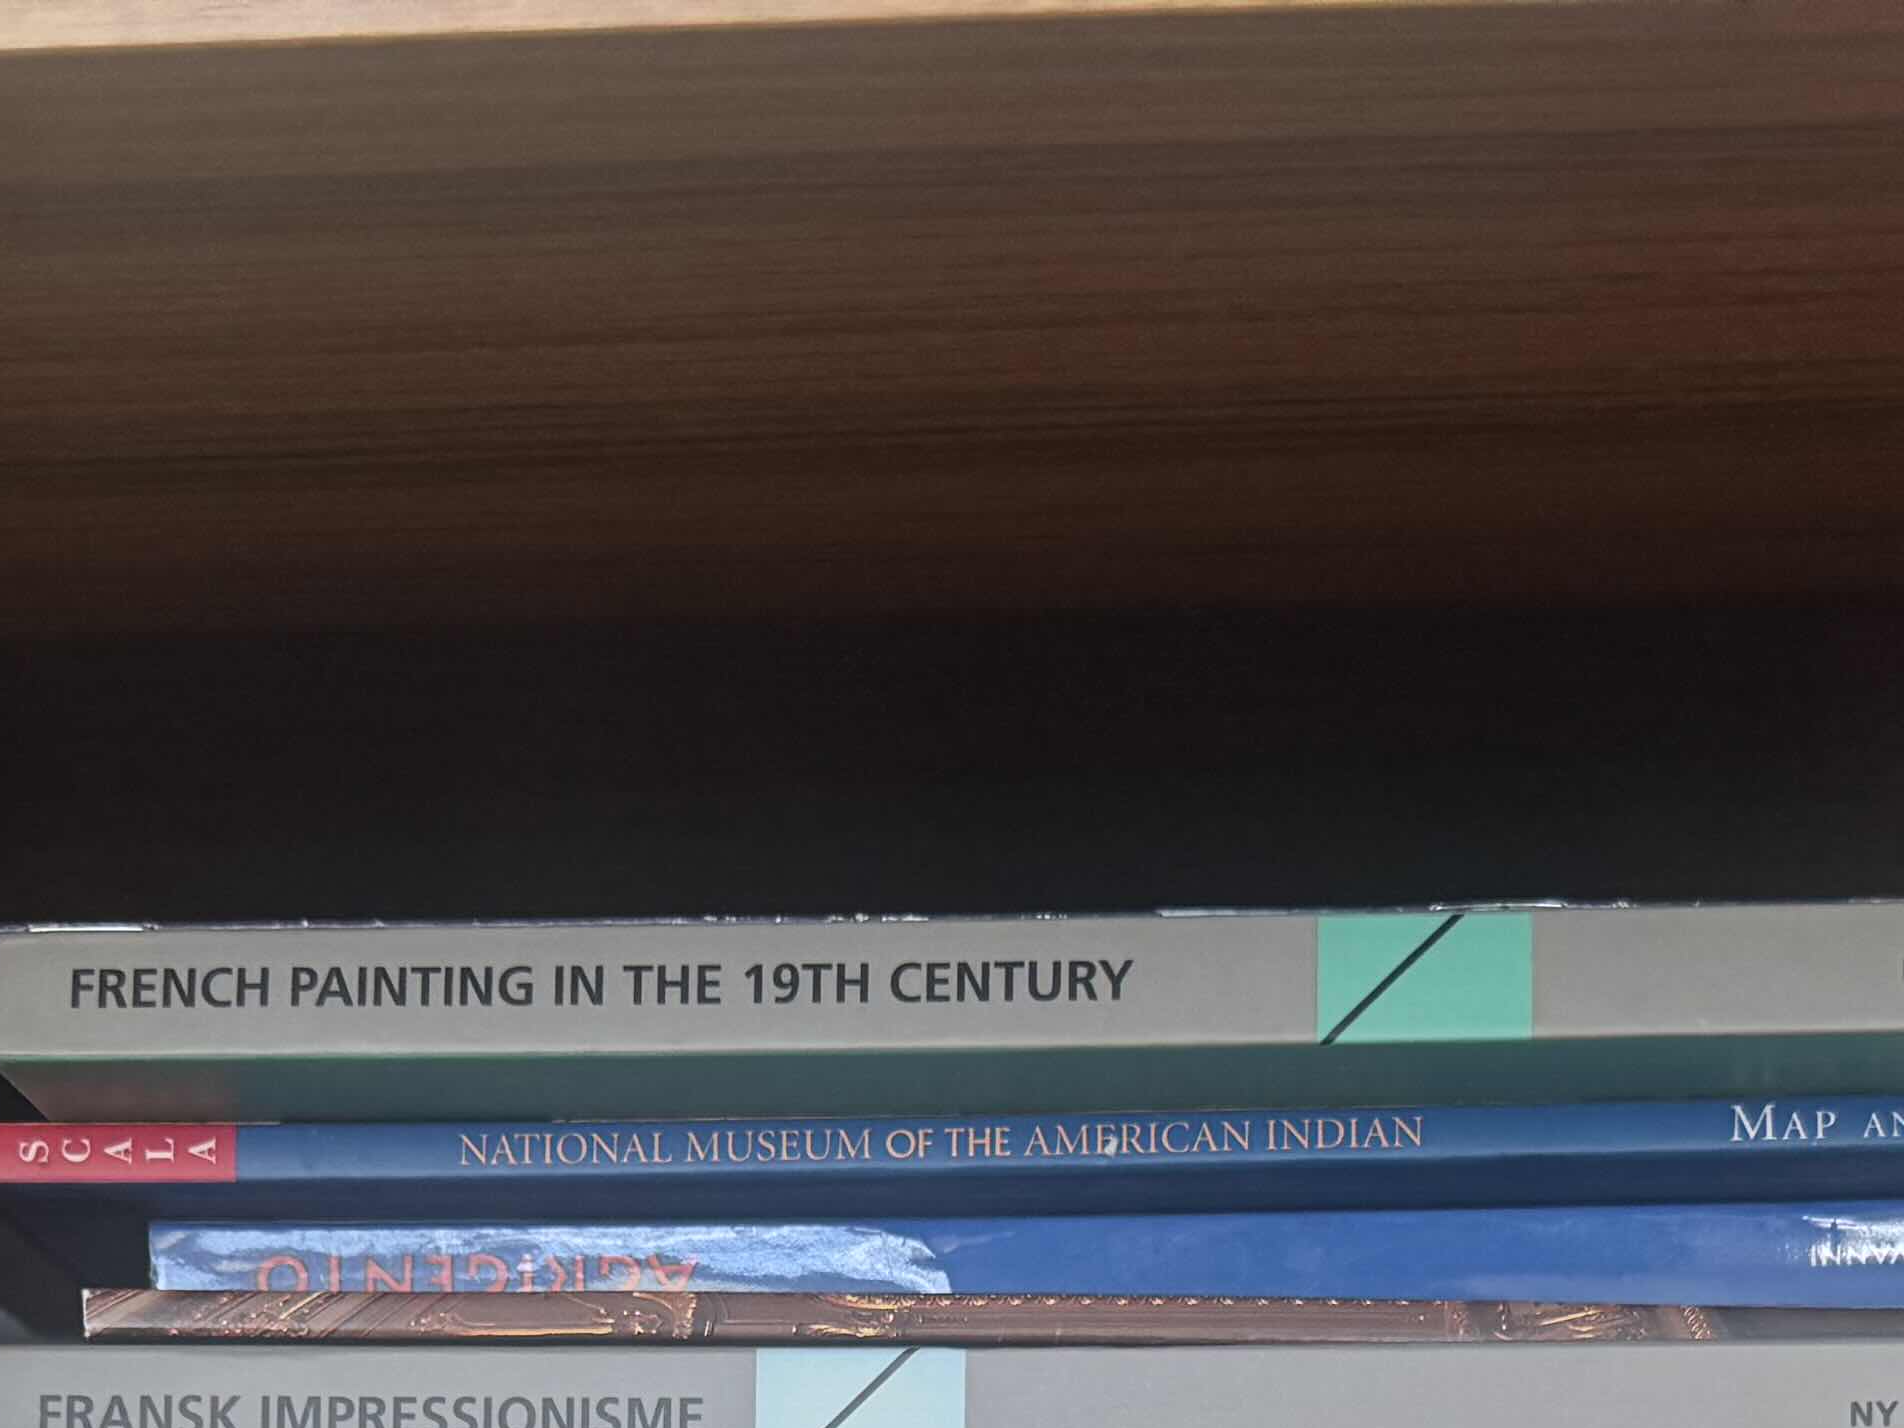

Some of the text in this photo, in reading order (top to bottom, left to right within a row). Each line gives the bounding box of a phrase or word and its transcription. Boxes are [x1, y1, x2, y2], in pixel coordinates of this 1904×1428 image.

[70, 959, 1133, 1009] FRENCH PAINTING IN THE 19TH CENTURY
[460, 1116, 1423, 1165] NATIONAL MUSEUM OF THE AMERICAN INDIAN
[1850, 1401, 1897, 1427] NY
